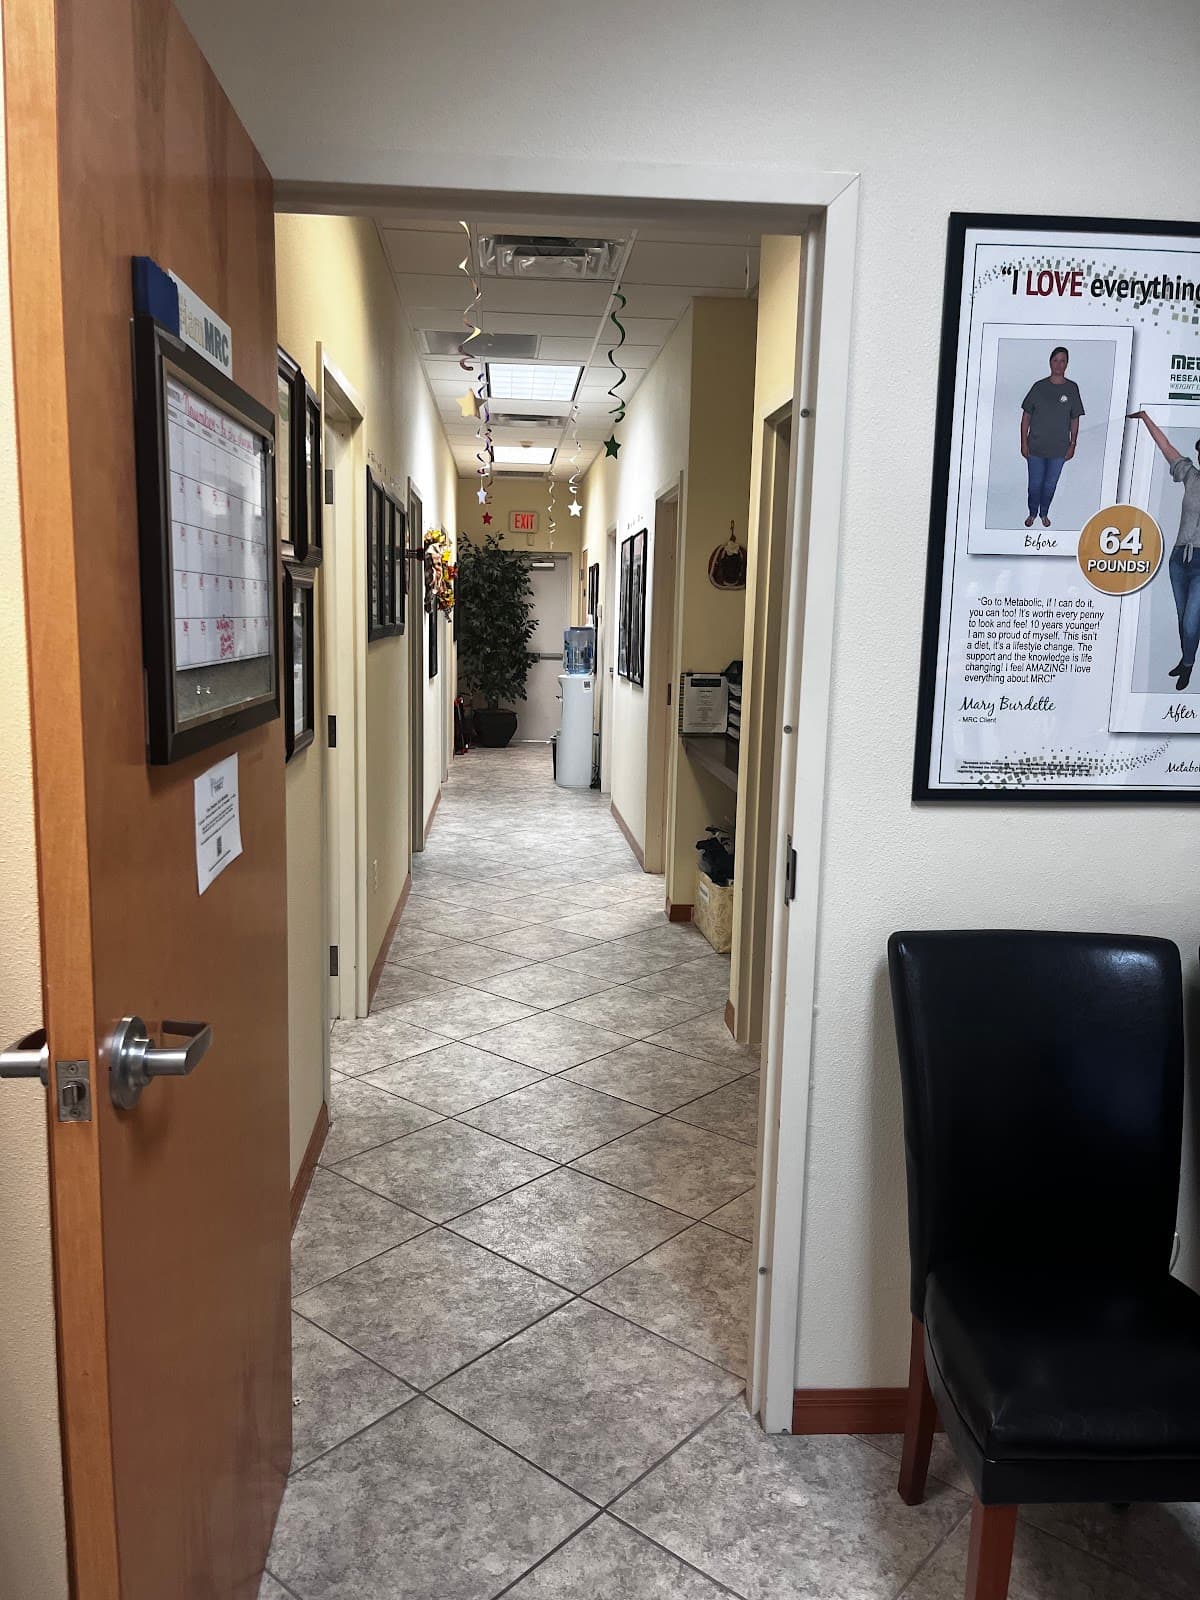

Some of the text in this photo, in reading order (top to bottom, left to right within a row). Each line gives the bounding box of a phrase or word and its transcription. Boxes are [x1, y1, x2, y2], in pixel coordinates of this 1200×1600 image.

[1026, 270, 1084, 297] LOVE
[1170, 374, 1200, 382] RESEA
[514, 513, 535, 529] EXIT
[1024, 533, 1058, 551] Before
[1099, 526, 1143, 555] 64
[1087, 559, 1151, 573] POUNDS!
[995, 598, 1002, 606] to
[1004, 597, 1044, 609] Metabolic,
[1058, 599, 1073, 608] can
[1075, 599, 1086, 608] do
[969, 608, 1105, 621] you can too! It's worth every penny
[968, 618, 1100, 631] to look and feel 10 years younger!
[972, 631, 985, 639] am
[987, 631, 996, 639] so
[998, 630, 1021, 641] proud
[1022, 630, 1032, 640] of
[1032, 630, 1060, 641] myself.
[1063, 631, 1080, 640] This
[1081, 631, 1098, 640] isn't
[966, 641, 1093, 653] a diet, it's a lifestyle change. The
[966, 653, 1093, 664] support and the knowledge is life
[965, 663, 1004, 673] changing!
[1010, 663, 1024, 672] feel
[1025, 663, 1068, 673] AMAZING!
[1074, 664, 1091, 673] love
[964, 674, 1005, 684] everything
[1006, 674, 1029, 683] about
[958, 695, 1057, 717] Mary Burdette
[1161, 704, 1198, 722] After
[1165, 760, 1200, 773] Metabo
